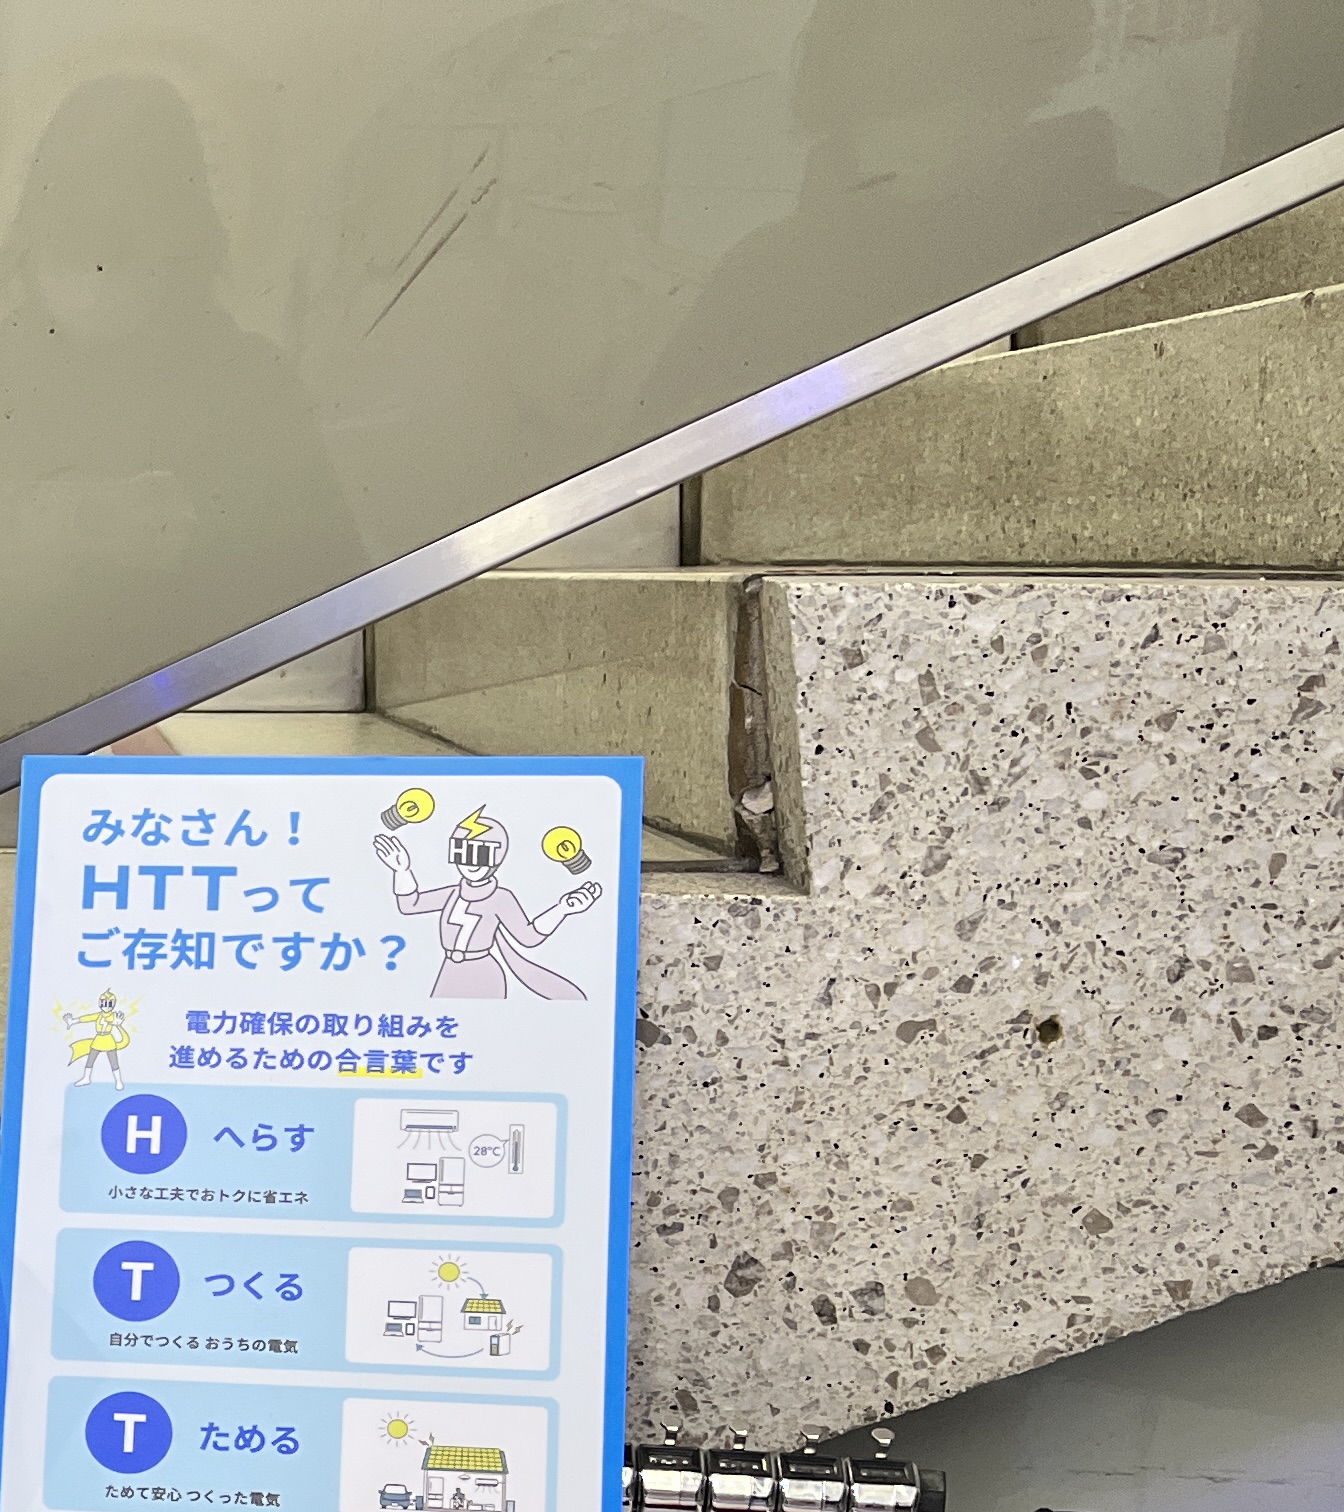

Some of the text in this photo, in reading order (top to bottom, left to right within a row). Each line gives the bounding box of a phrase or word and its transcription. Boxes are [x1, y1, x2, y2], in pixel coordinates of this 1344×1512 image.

[81, 808, 302, 847] みなさん！
[82, 864, 331, 914] HTTって
[77, 927, 407, 972] ご存知ですか？
[185, 1010, 460, 1040] 電力確保の取り組みを
[169, 1045, 474, 1076] 進めるための合言葉です
[126, 1116, 162, 1155] H
[213, 1122, 315, 1153] へらす
[108, 1185, 309, 1205] 小さな工夫でおトクに省エネ
[120, 1262, 154, 1301] T
[205, 1270, 304, 1302] つくる
[109, 1333, 299, 1355] 自分でつくる おうちの電気
[113, 1414, 146, 1453] T
[199, 1423, 300, 1455] ためる
[105, 1485, 281, 1508] ためて安心 つくった電気
